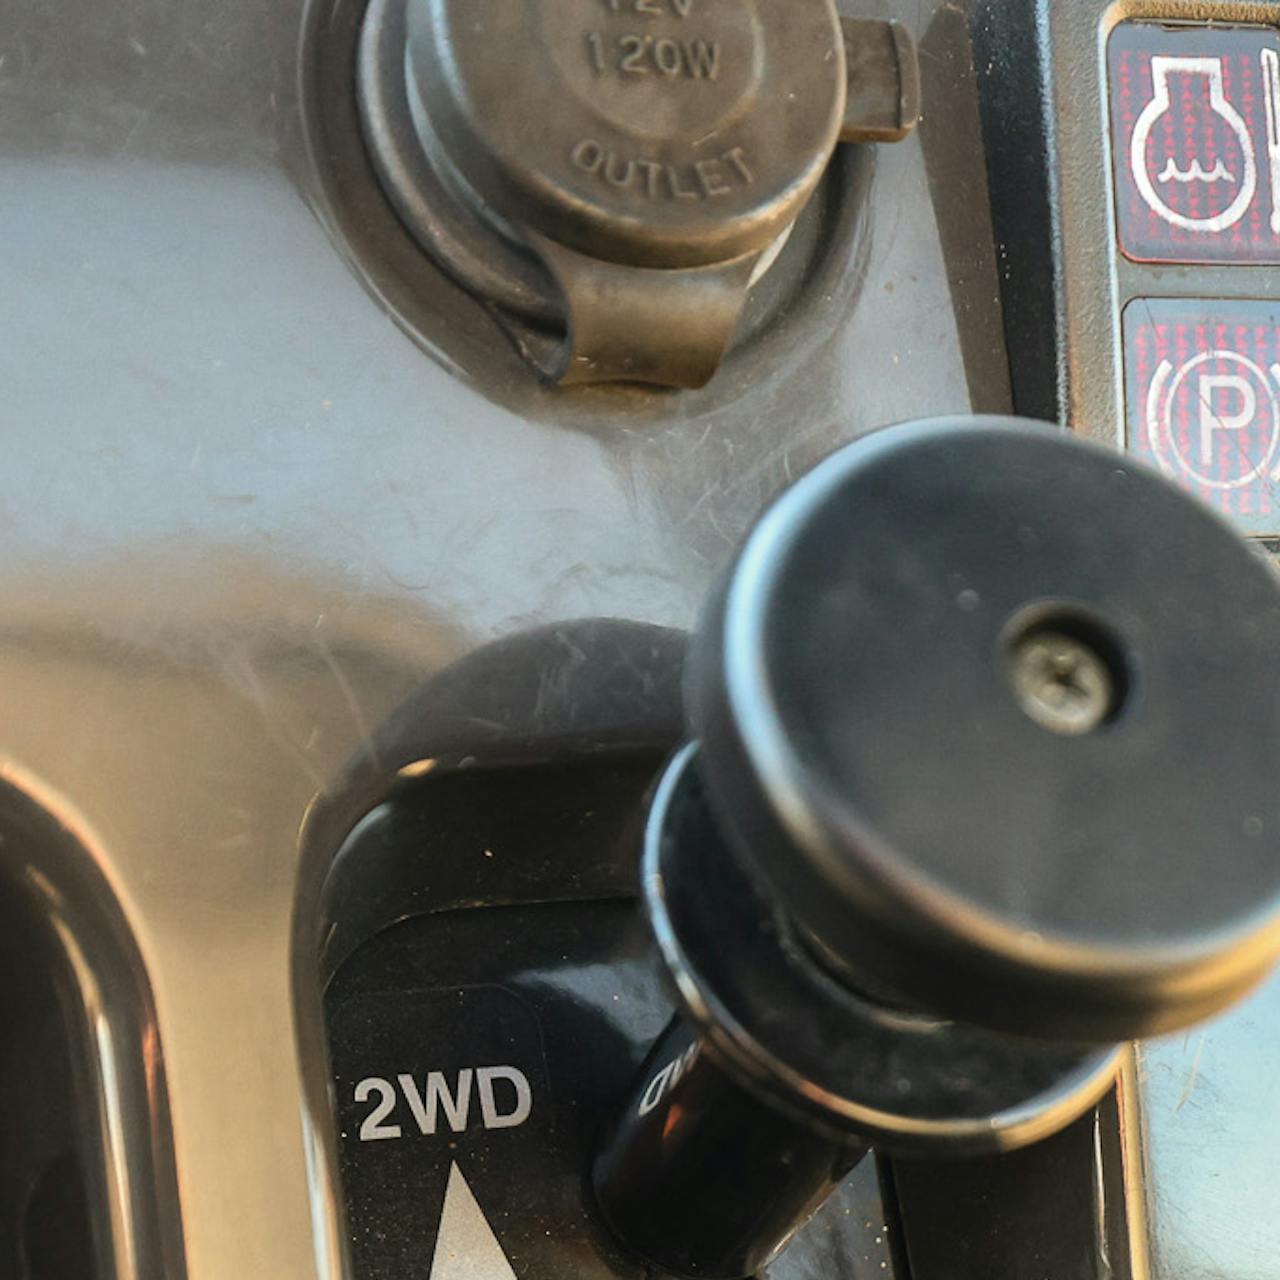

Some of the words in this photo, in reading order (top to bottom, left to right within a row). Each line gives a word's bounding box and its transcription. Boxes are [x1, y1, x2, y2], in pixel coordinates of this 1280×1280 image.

[586, 31, 721, 81] 120W
[571, 138, 756, 199] OUTLET
[353, 1065, 533, 1142] 2WD
